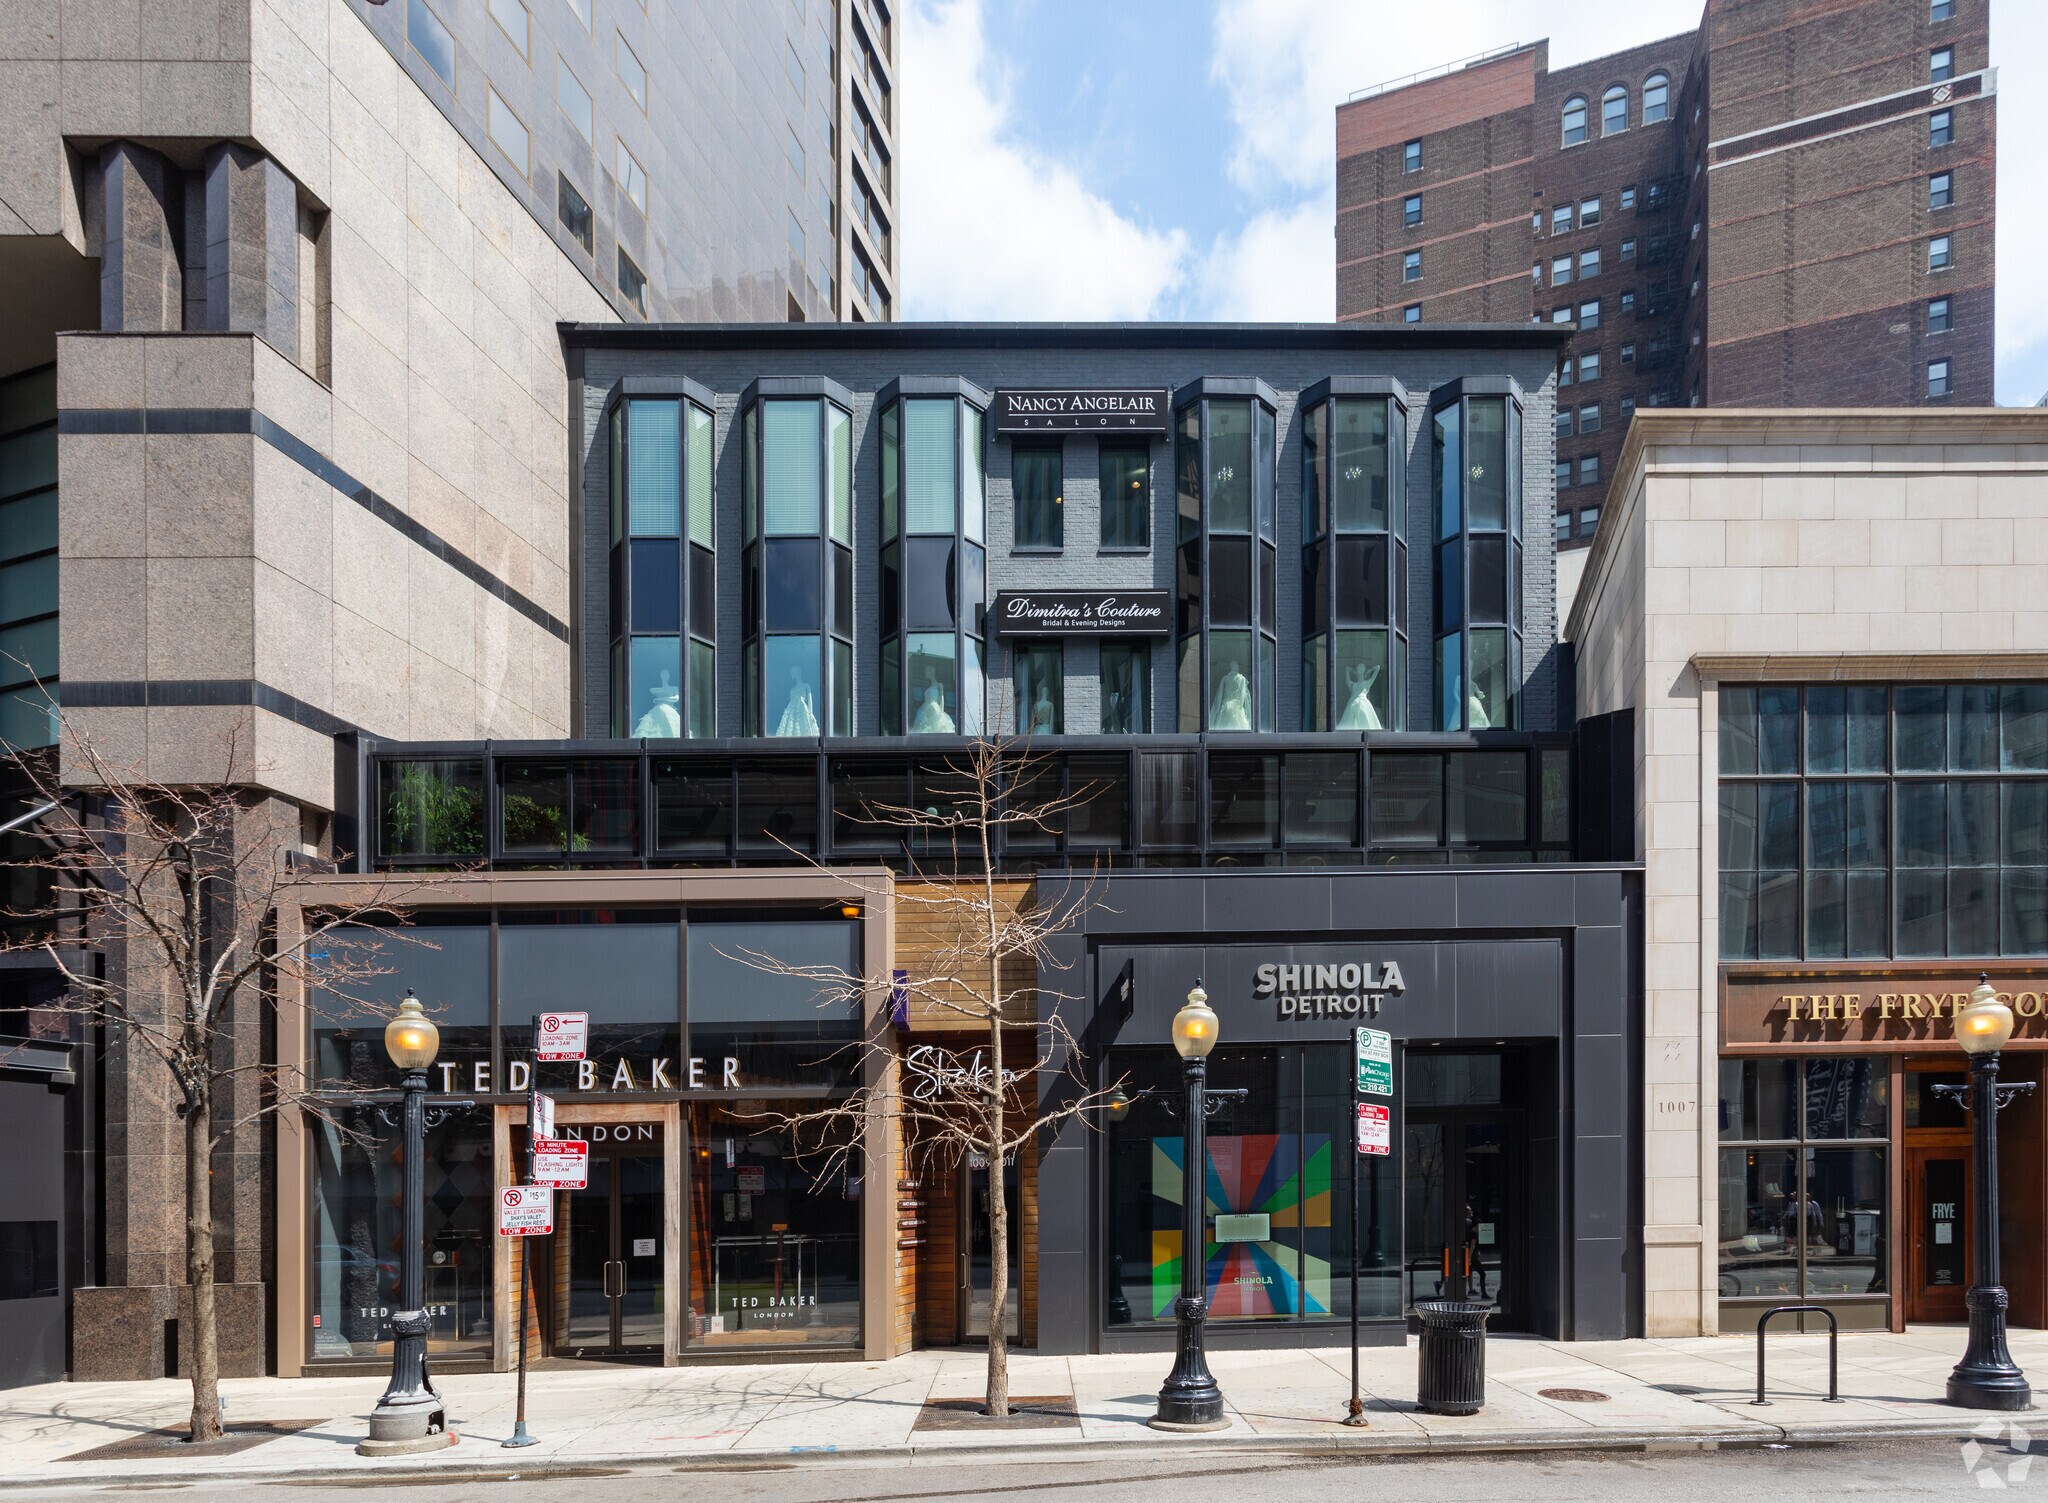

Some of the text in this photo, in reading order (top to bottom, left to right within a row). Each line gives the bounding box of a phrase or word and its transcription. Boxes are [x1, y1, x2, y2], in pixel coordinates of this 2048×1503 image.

[1008, 395, 1156, 411] NANCY ANGELAIR
[1024, 418, 1136, 426] SALON
[1007, 597, 1162, 618] Dimitra's Couture
[1071, 619, 1098, 628] Evening
[1100, 619, 1126, 627] Designs
[1255, 961, 1406, 994] SHINOLA
[1280, 994, 1385, 1015] DETROIT
[1782, 994, 1861, 1020] THE
[1878, 993, 1969, 1019] FRYE
[438, 1057, 742, 1093] TED BAKER
[1659, 1101, 1696, 1113] 1007
[553, 1125, 652, 1141] NDON
[1932, 1203, 1956, 1219] FRYE
[525, 1226, 547, 1234] ZONE
[1233, 1276, 1273, 1286] SHINOLA
[732, 1295, 815, 1308] TED BAKER
[360, 1307, 388, 1318] TED
[753, 1311, 794, 1319] LONDON
